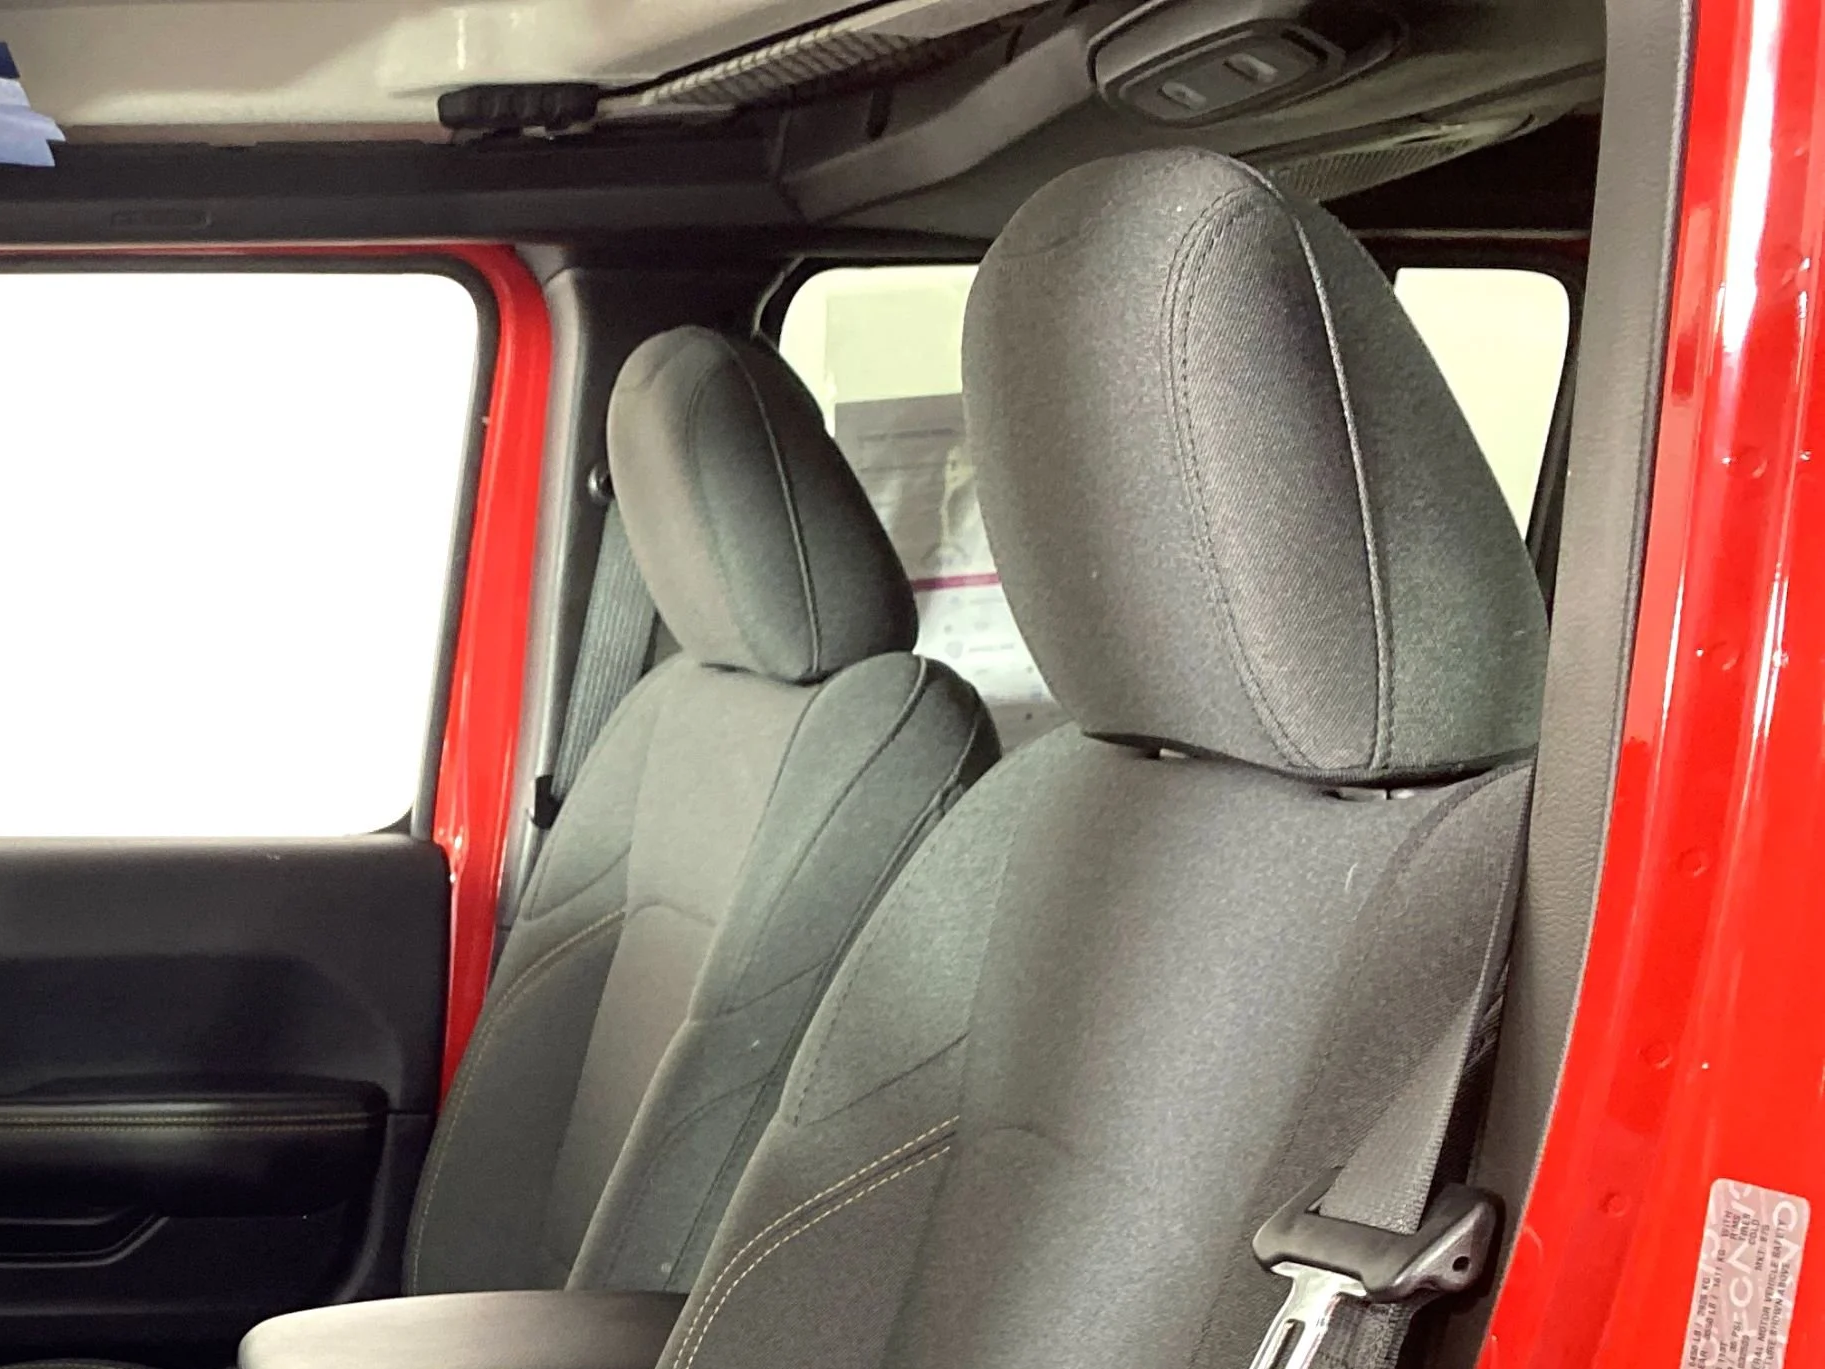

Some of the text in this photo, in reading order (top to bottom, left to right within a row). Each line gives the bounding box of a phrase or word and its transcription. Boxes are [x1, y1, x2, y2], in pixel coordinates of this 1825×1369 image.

[1748, 1219, 1759, 1245] COLD
[1756, 1305, 1770, 1341] MOTOR
[1763, 1260, 1778, 1303] VEHICLE
[1771, 1219, 1786, 1258] SAFETY
[1769, 1297, 1783, 1336] SHOWN
